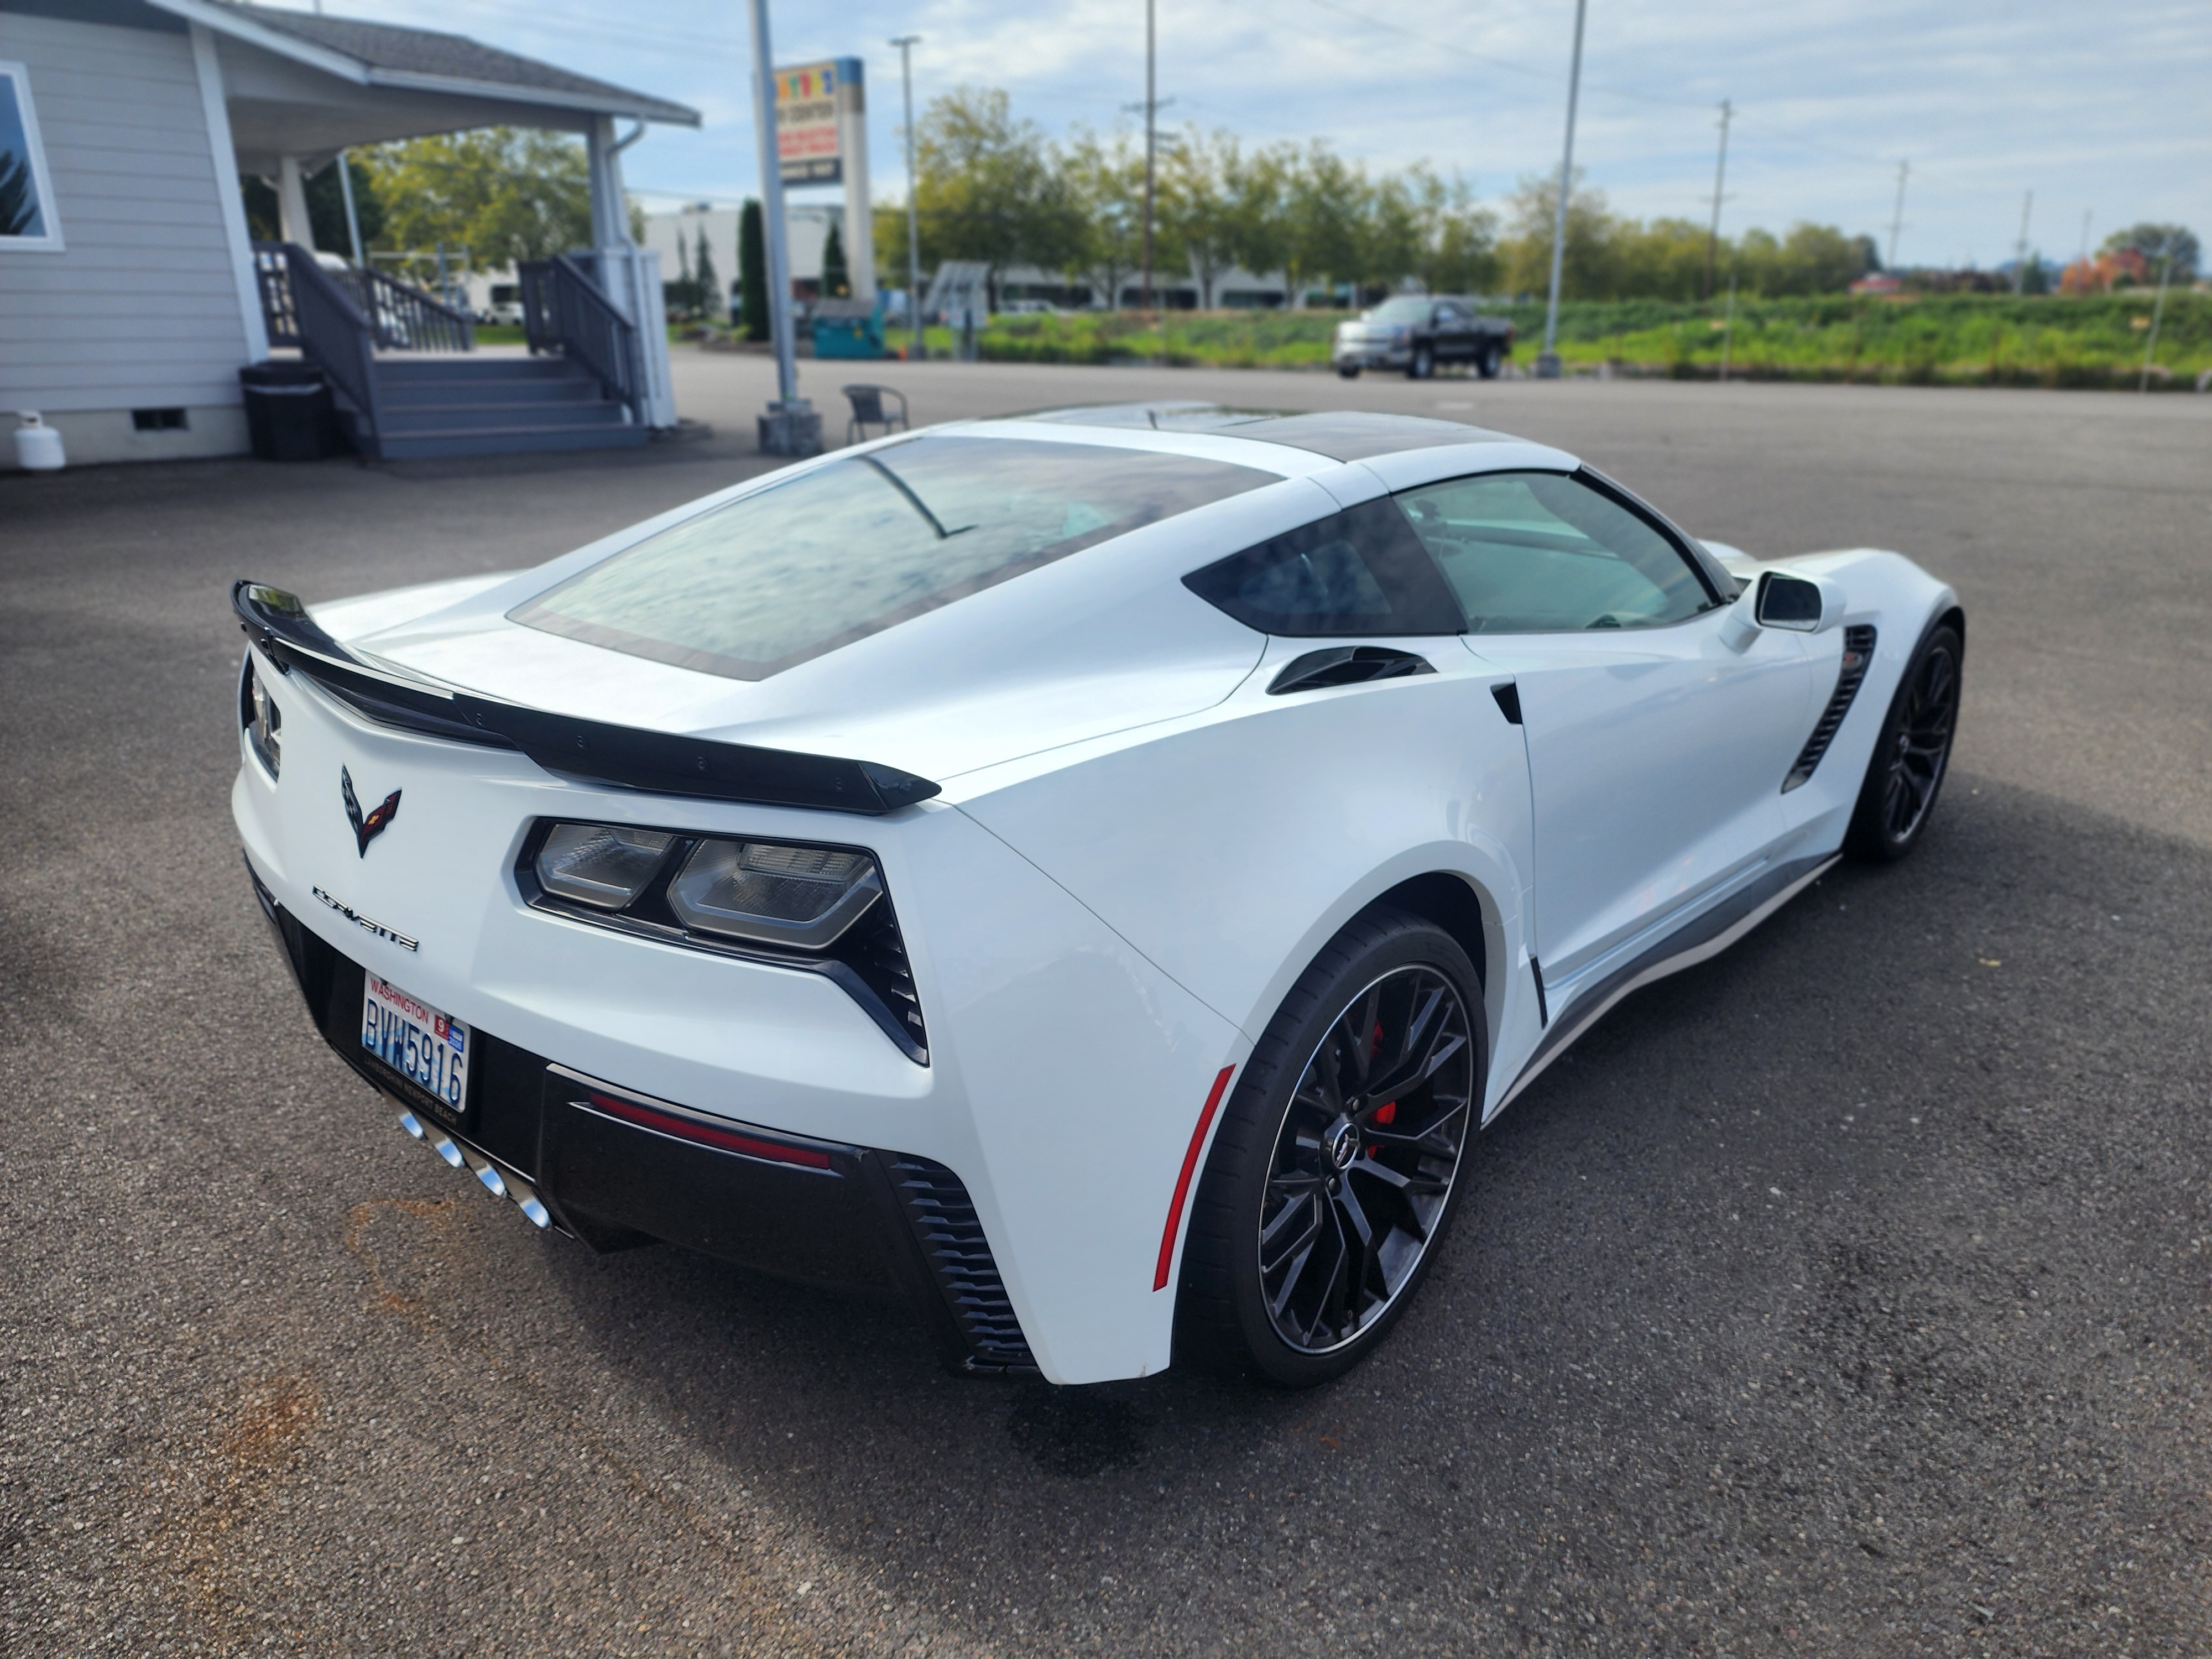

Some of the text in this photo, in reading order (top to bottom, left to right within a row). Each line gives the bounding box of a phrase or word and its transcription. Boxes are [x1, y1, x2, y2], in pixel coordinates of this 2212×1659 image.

[312, 884, 419, 951] CORVETTE
[370, 977, 429, 1024] WASHINGTON
[437, 1019, 445, 1032] 9
[365, 998, 463, 1106] BVW5916
